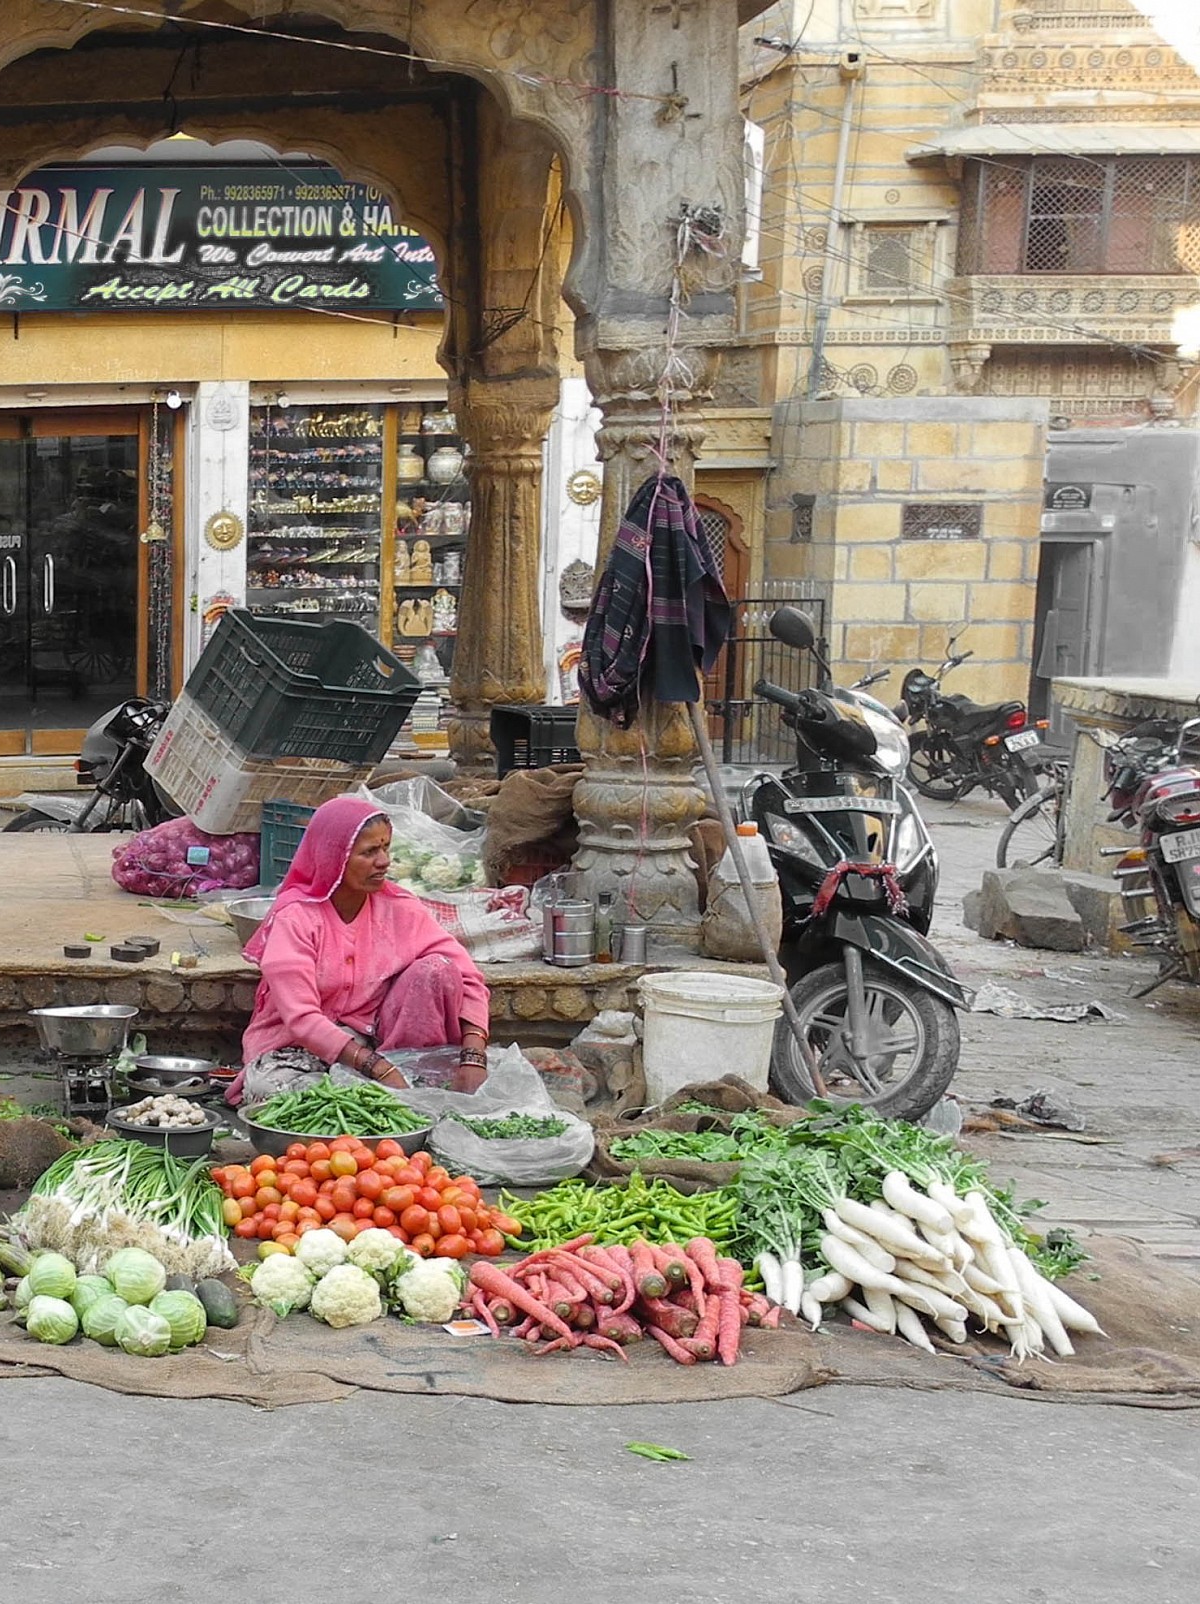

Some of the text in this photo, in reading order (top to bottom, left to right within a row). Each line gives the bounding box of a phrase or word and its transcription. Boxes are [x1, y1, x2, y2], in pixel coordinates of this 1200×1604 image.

[197, 205, 333, 237] COLLECTION
[338, 202, 356, 237] &
[200, 244, 238, 263] We
[246, 242, 335, 267] Convert
[337, 243, 387, 264] Art
[82, 274, 369, 302] Accept All Cards
